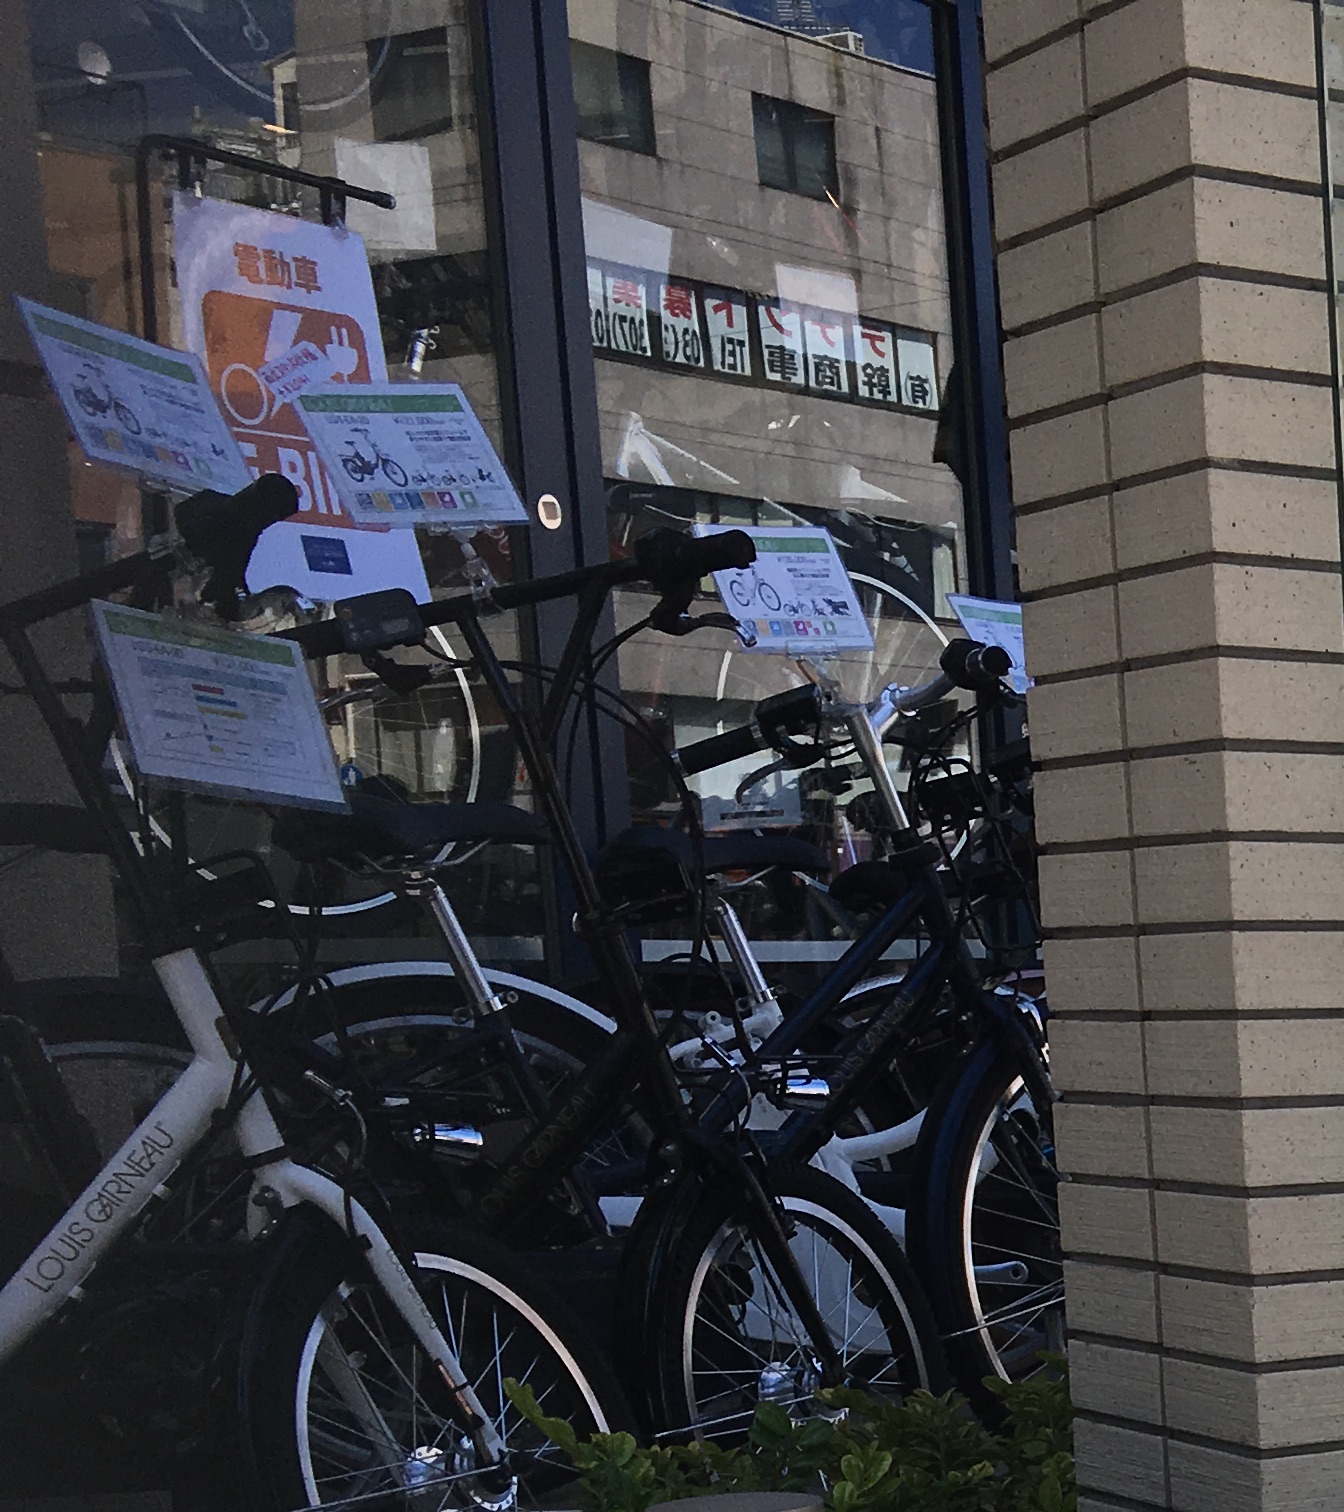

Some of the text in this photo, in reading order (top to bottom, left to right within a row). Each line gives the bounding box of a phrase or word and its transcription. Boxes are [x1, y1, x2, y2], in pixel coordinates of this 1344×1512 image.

[234, 242, 321, 294] 電動車
[25, 1124, 174, 1293] LOUIS GARNEAU
